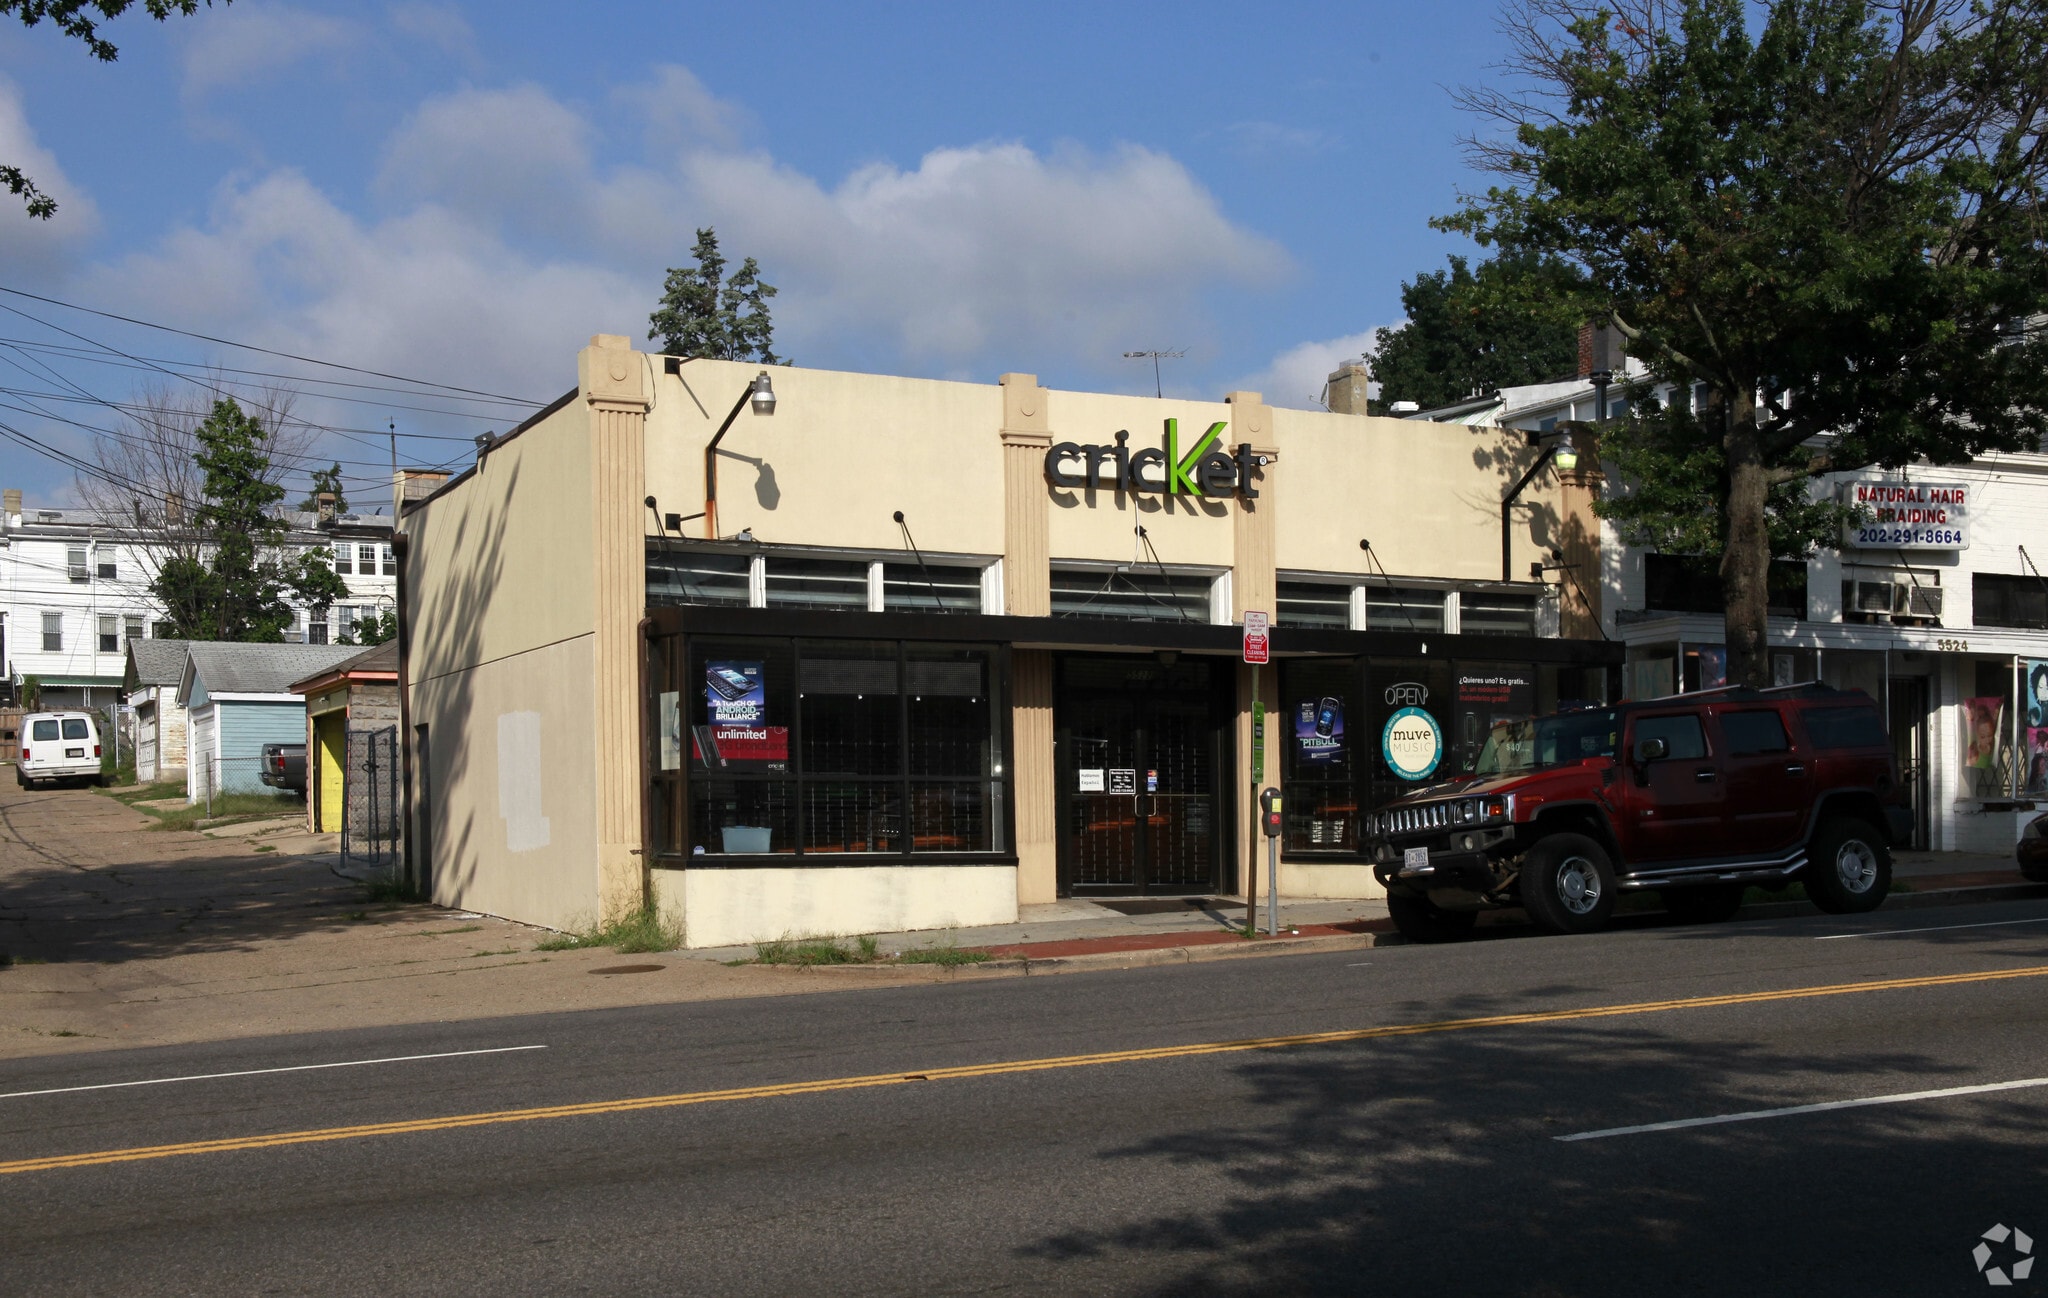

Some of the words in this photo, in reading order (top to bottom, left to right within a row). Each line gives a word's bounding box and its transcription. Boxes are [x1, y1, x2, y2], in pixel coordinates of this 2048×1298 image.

[1858, 487, 1925, 503] NATURAL
[1931, 489, 1965, 504] HAIR
[1877, 508, 1946, 524] BRAIDING
[1860, 529, 1962, 543] 202-291-8664
[1938, 639, 1968, 652] 5524
[1385, 687, 1426, 705] OPEN
[717, 730, 766, 740] unlimited
[1394, 730, 1431, 740] muve
[1394, 742, 1431, 752] MUSIC
